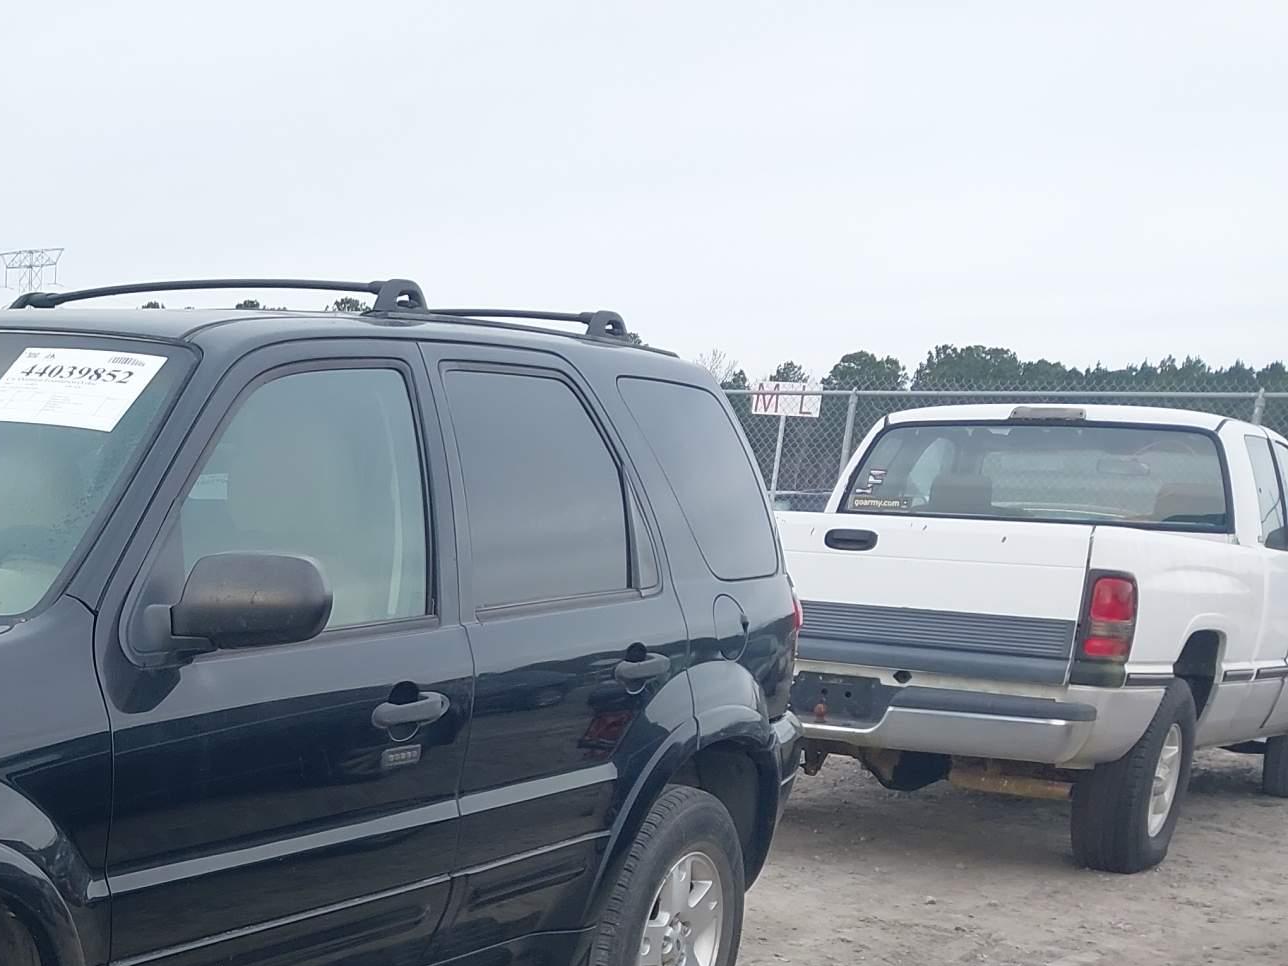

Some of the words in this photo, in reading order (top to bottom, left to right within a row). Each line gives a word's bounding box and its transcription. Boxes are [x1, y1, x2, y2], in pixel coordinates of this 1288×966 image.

[20, 363, 134, 384] 44039852
[755, 383, 779, 412] M
[854, 499, 900, 507] goarmy.com
